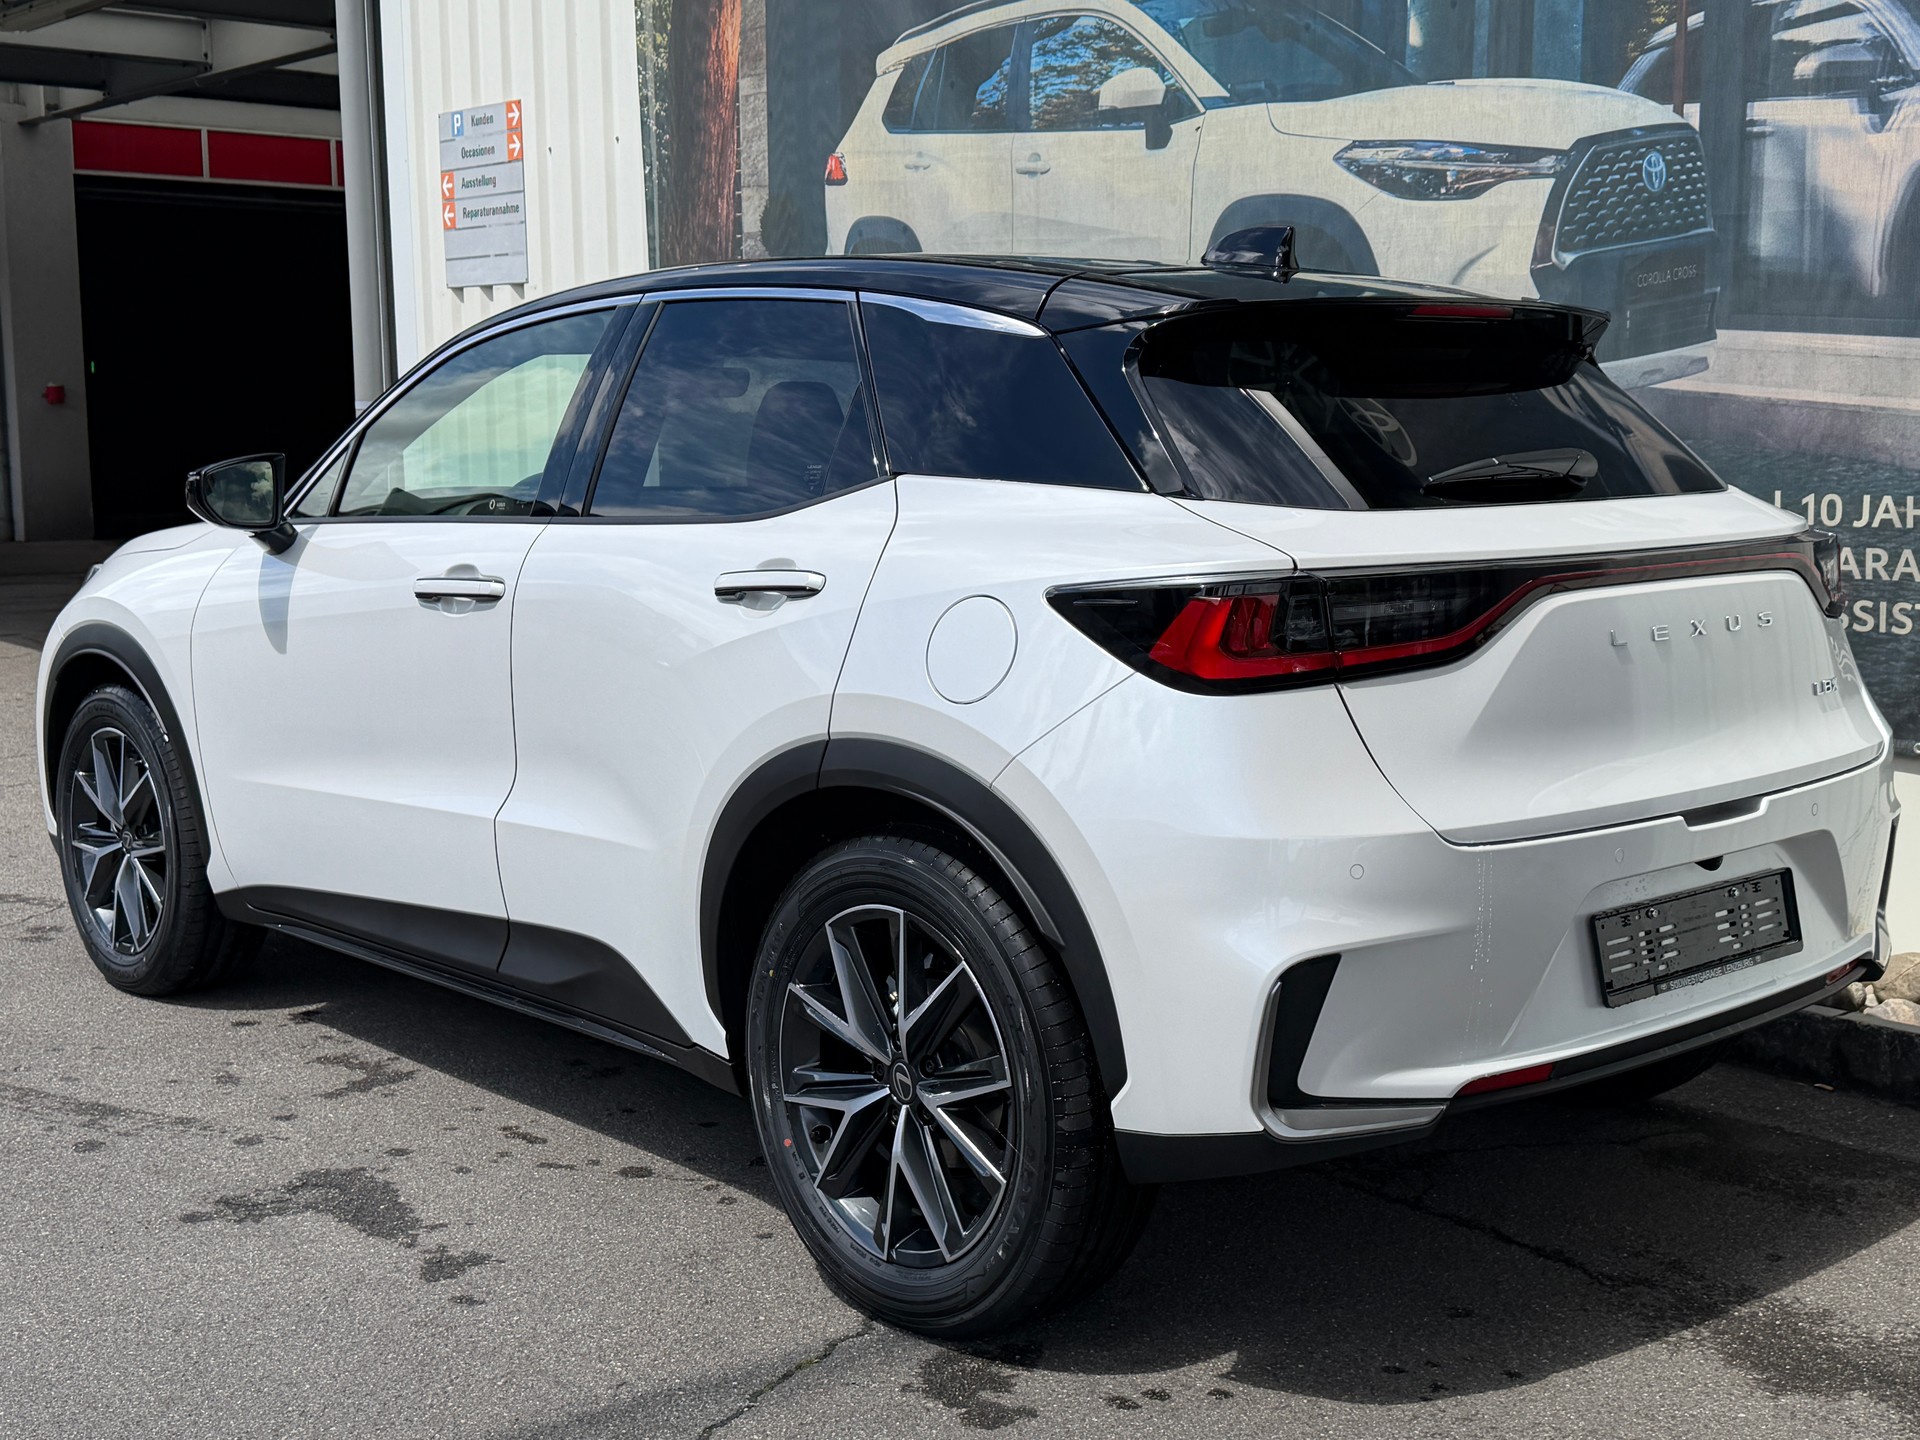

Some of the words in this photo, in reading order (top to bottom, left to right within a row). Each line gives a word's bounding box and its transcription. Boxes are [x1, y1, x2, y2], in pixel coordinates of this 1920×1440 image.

[454, 113, 461, 135] P
[471, 114, 494, 127] Kunden
[461, 144, 495, 159] Occasionen
[461, 174, 497, 190] Ausstellung
[462, 203, 520, 221] Reparaturannahme
[1672, 264, 1697, 281] CROSS
[1801, 493, 1842, 527] 10
[1610, 611, 1774, 647] LEXUS
[1812, 677, 1839, 696] LBX
